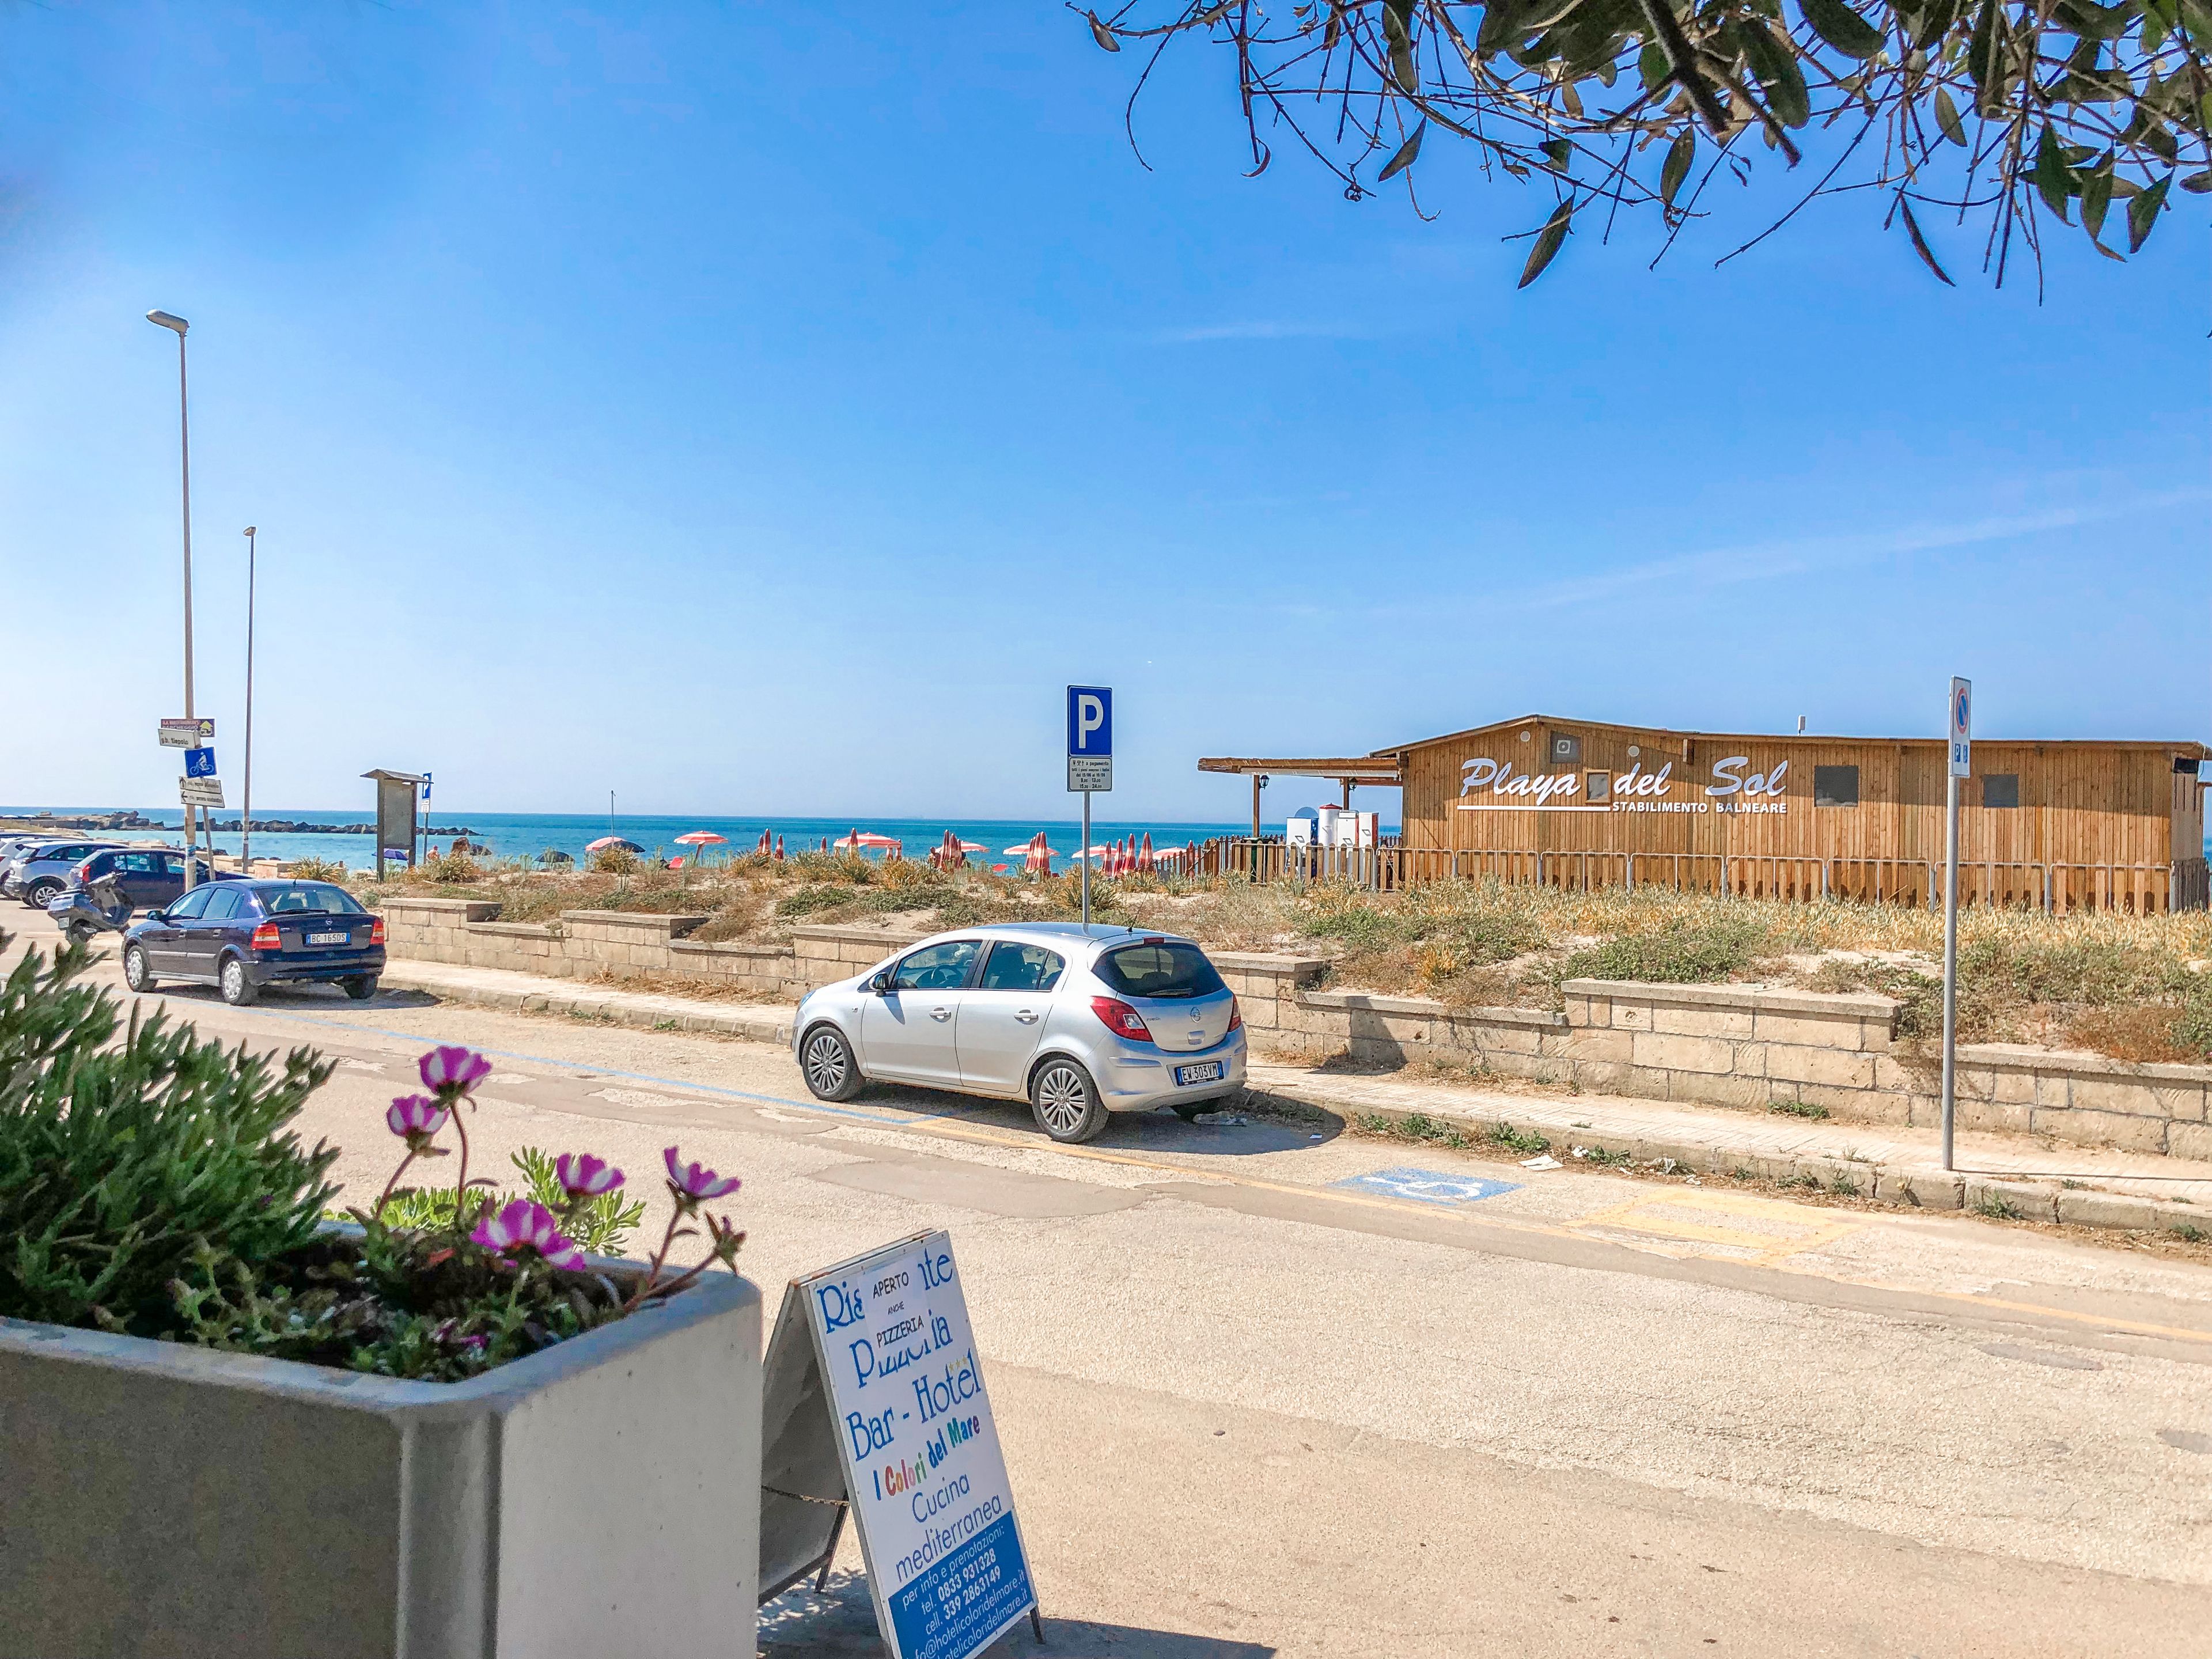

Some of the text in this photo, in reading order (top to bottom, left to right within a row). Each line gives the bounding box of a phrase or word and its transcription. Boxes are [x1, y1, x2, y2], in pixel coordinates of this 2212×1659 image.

[1078, 695, 1104, 749] P
[1460, 756, 1788, 806] Playa del Sol
[1612, 801, 1787, 814] STABILIMENTO BALNEARE
[324, 934, 346, 942] 165DS
[1182, 1063, 1218, 1081] EW 303VM
[873, 1271, 909, 1299] APERTO
[888, 1301, 905, 1315] ANCHE
[876, 1315, 925, 1348] PIZZERIA
[846, 1407, 895, 1462] Bar
[912, 1347, 982, 1423] Hotel
[873, 1415, 980, 1501] I Colori del Mare
[912, 1474, 971, 1523] Cucina
[896, 1494, 1002, 1582] mediterranea
[903, 1522, 1005, 1611] per info e prenotazioni:
[922, 1548, 997, 1615] tel. 0833 931328
[925, 1565, 1001, 1635] cell. 339 2863149
